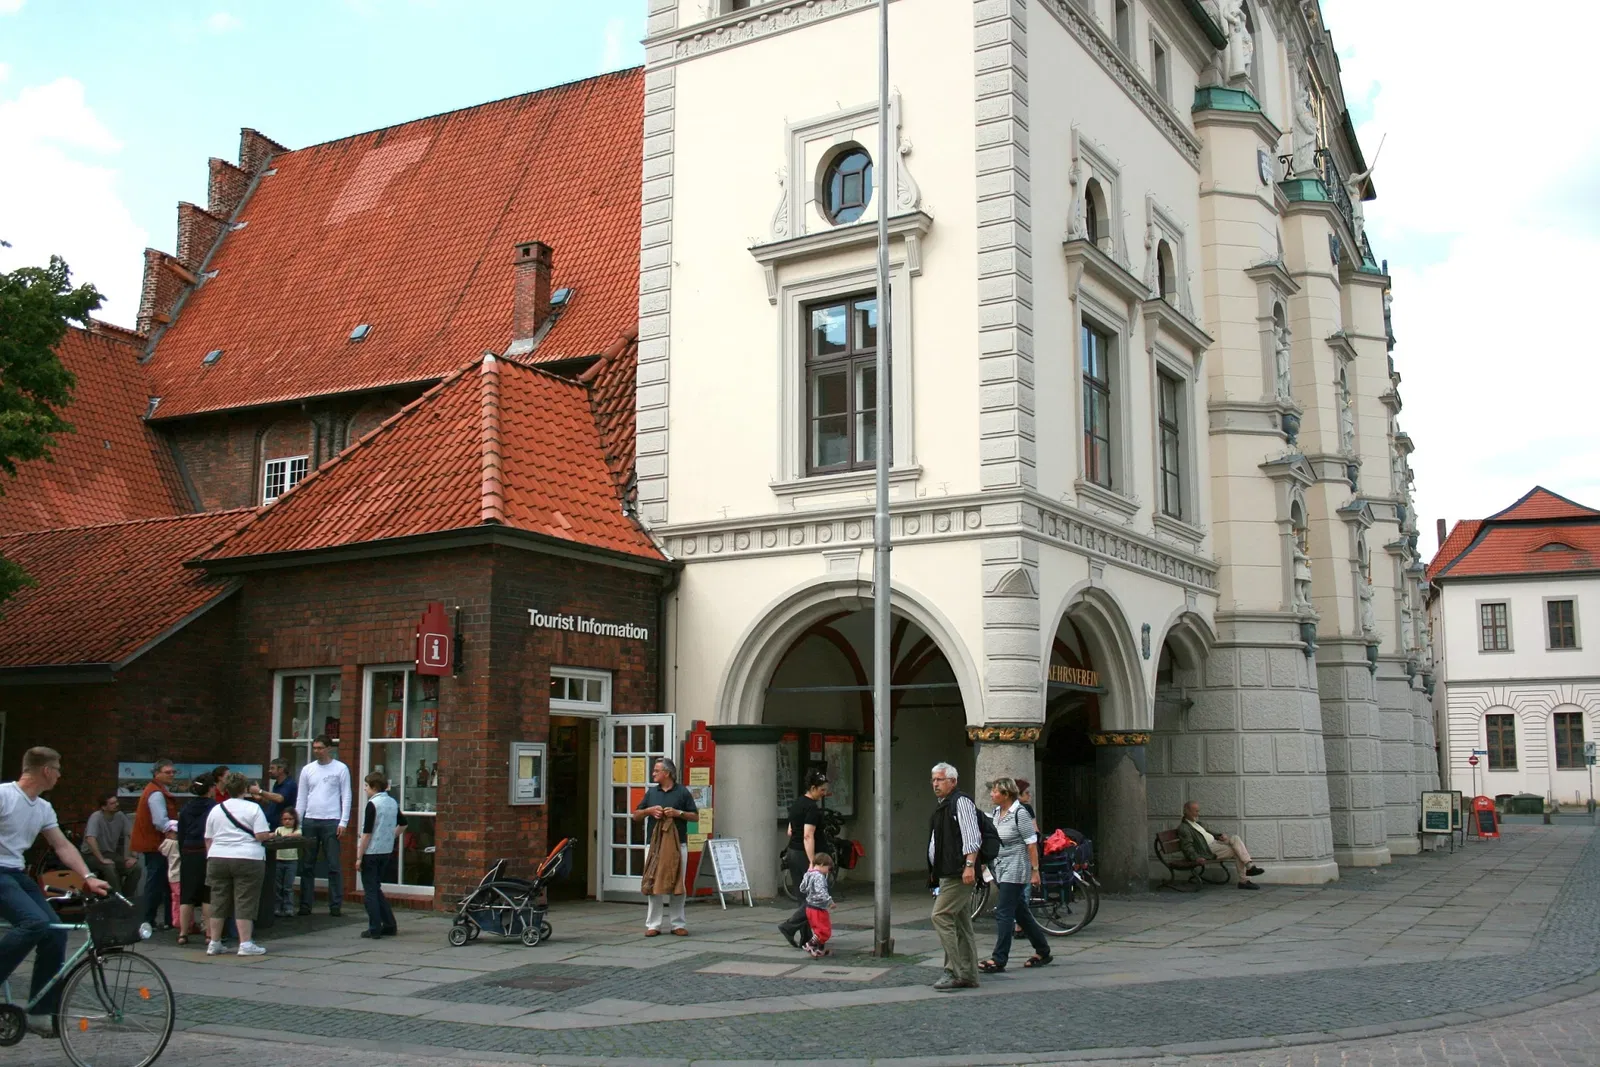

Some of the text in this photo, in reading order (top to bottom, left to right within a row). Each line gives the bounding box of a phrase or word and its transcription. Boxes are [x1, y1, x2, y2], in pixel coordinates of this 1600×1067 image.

[527, 608, 648, 640] Tourist Information
[432, 639, 440, 660] i
